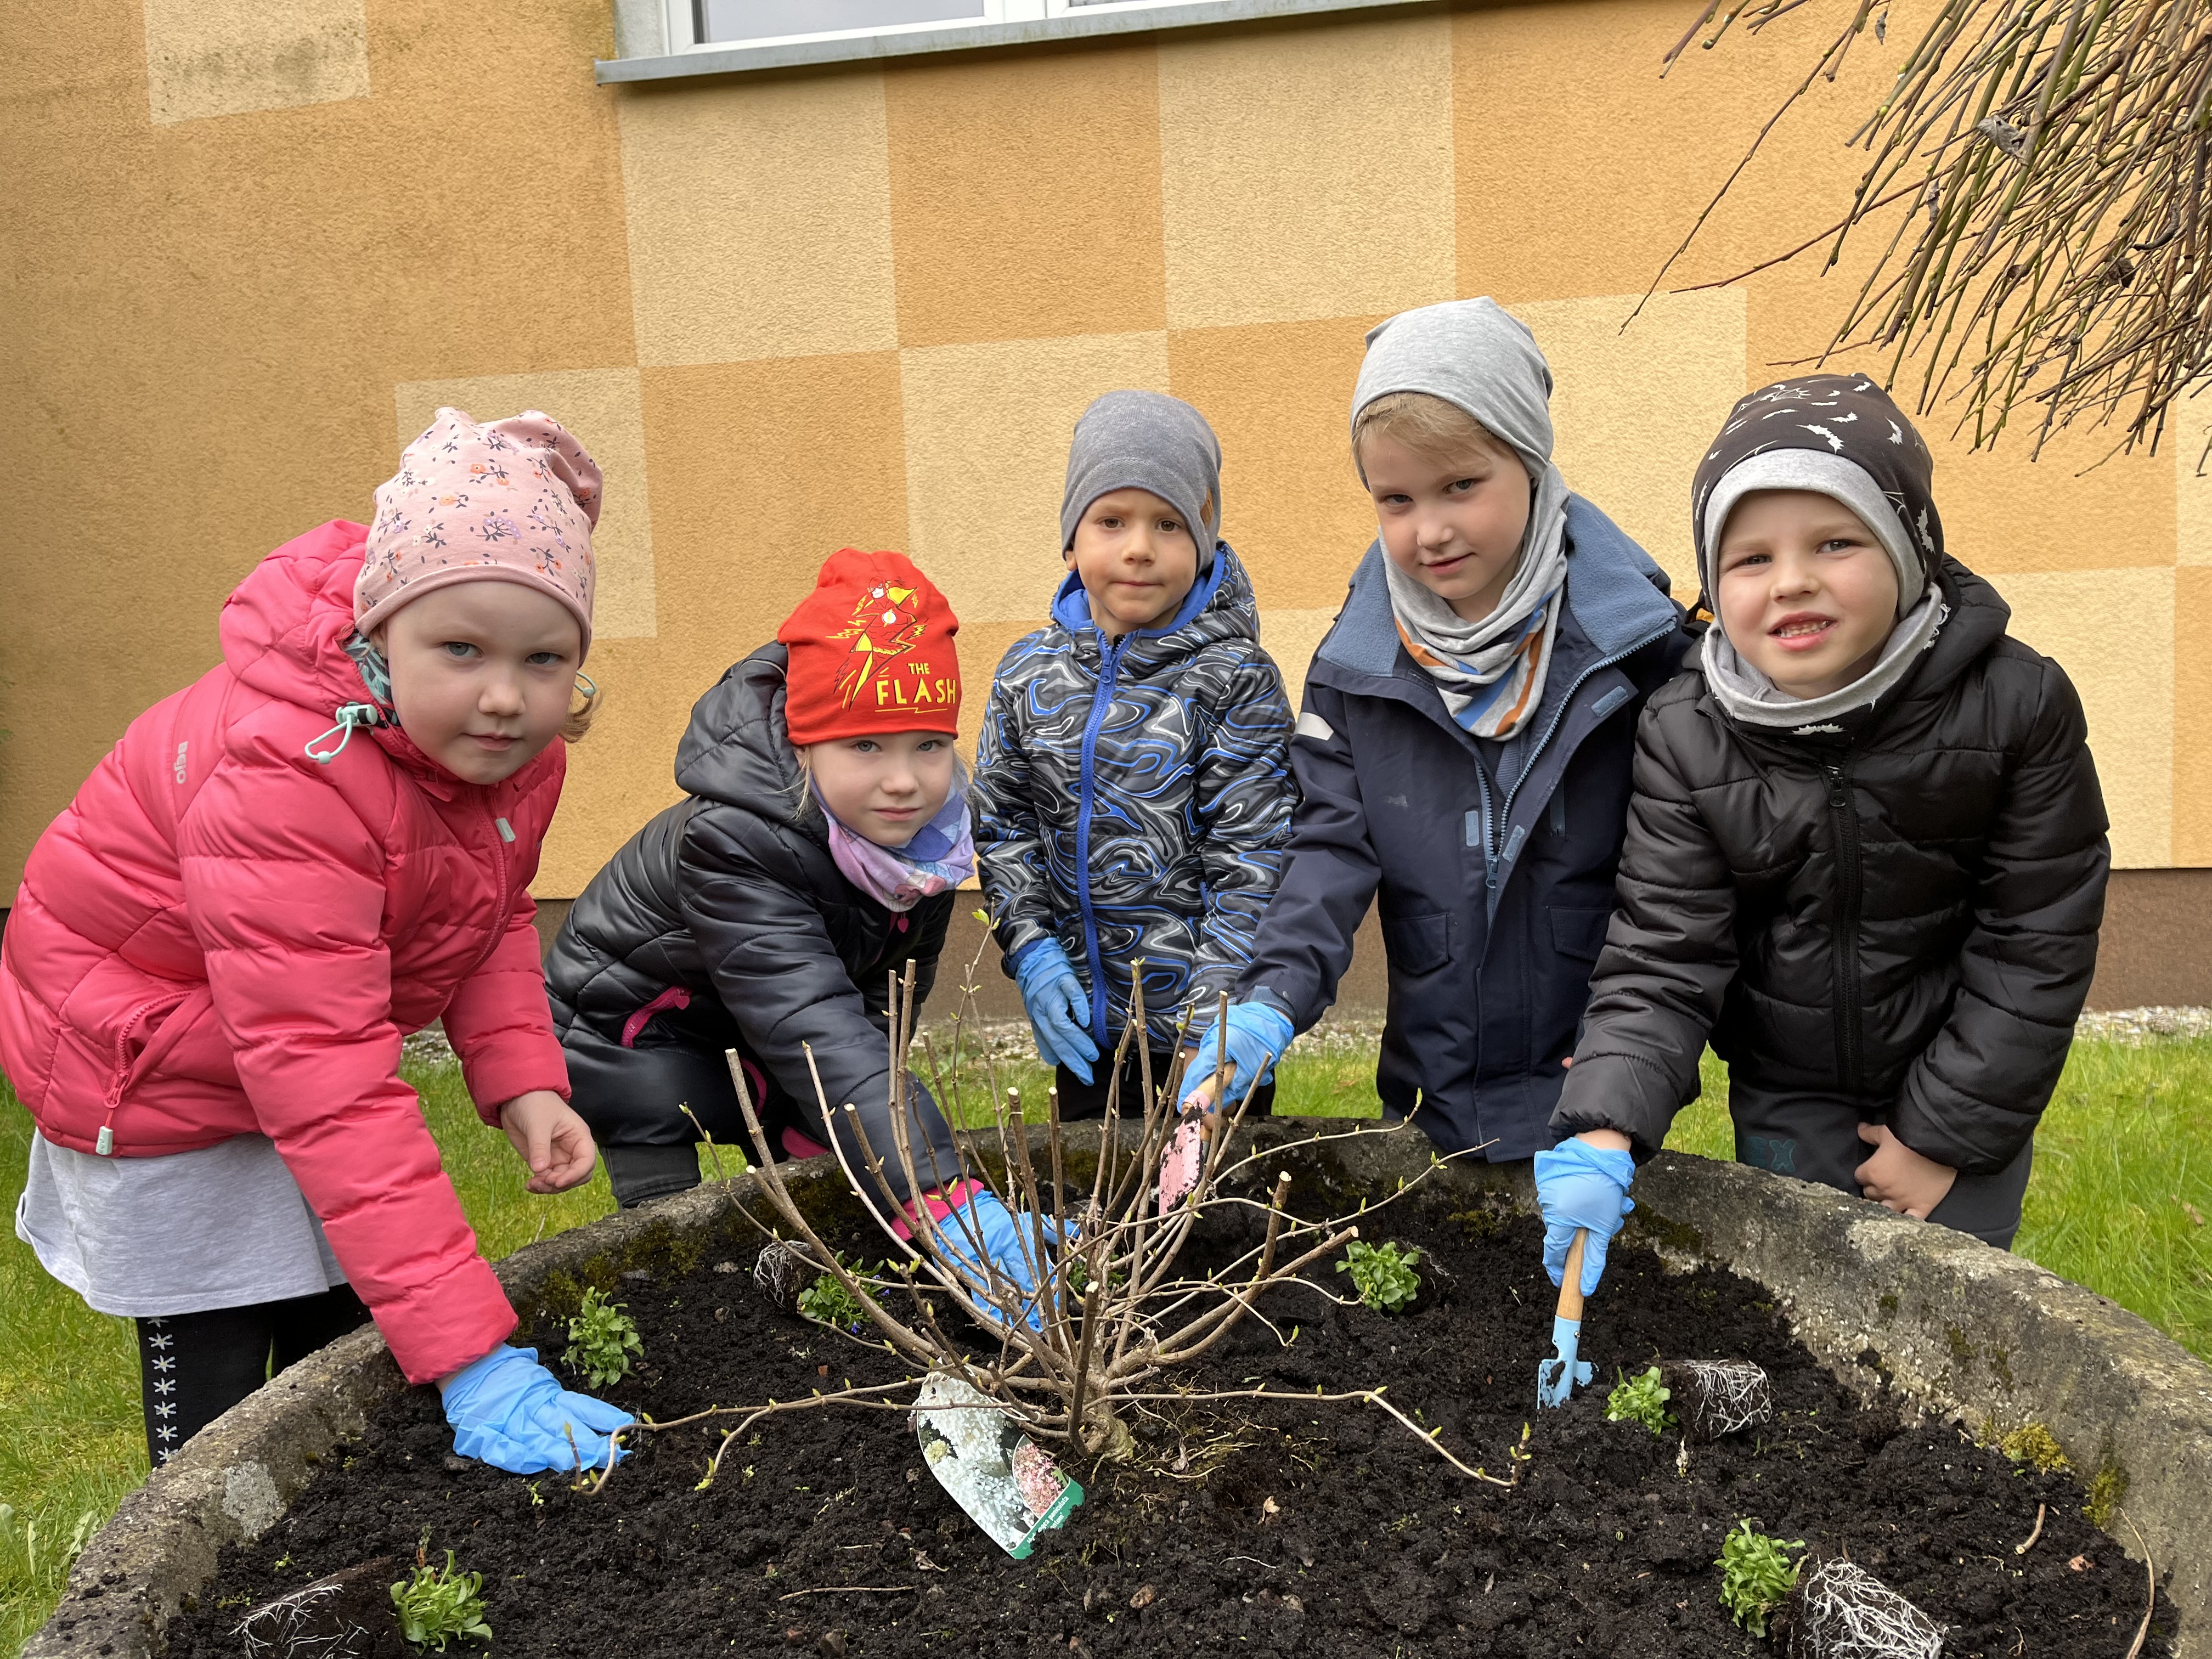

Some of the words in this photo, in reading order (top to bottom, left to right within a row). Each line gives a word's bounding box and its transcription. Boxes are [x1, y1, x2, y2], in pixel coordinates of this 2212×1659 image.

[907, 662, 930, 675] THE
[875, 678, 957, 706] FLASH
[1048, 1496, 1069, 1521] paniculata
